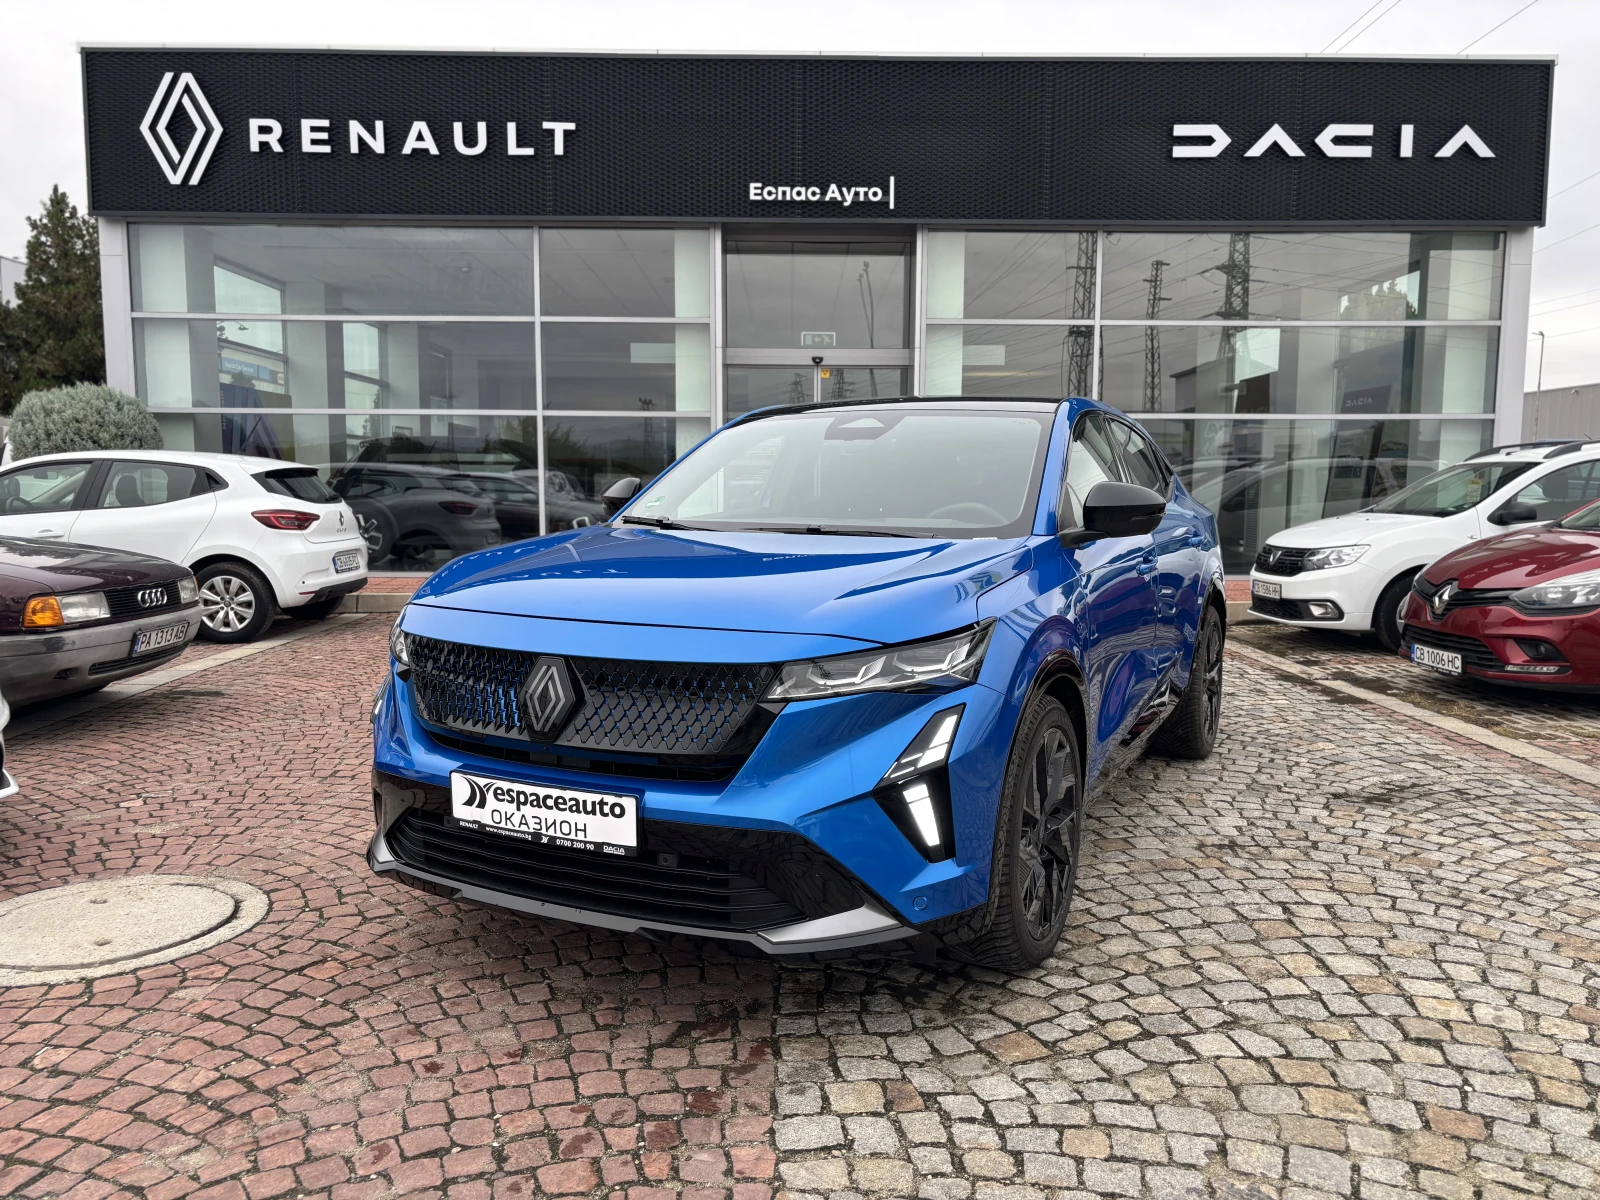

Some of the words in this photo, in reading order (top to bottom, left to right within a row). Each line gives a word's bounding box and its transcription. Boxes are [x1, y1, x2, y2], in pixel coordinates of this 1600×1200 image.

[249, 118, 576, 156] RENAULT
[1172, 123, 1496, 158] DACIA
[749, 182, 821, 201] Еспас
[825, 183, 883, 206] Ауто
[1345, 397, 1372, 407] DACIA
[1415, 646, 1425, 661] CB
[1426, 649, 1446, 667] 1006
[1447, 653, 1460, 670] HC
[493, 786, 626, 819] espaceauto
[459, 820, 479, 829] RENAULT
[485, 826, 532, 840] www.espaceauto.bg
[491, 809, 587, 839] ОКАЗИОН
[556, 838, 572, 847] 0700
[572, 841, 585, 849] 200
[603, 845, 625, 853] DACIA
